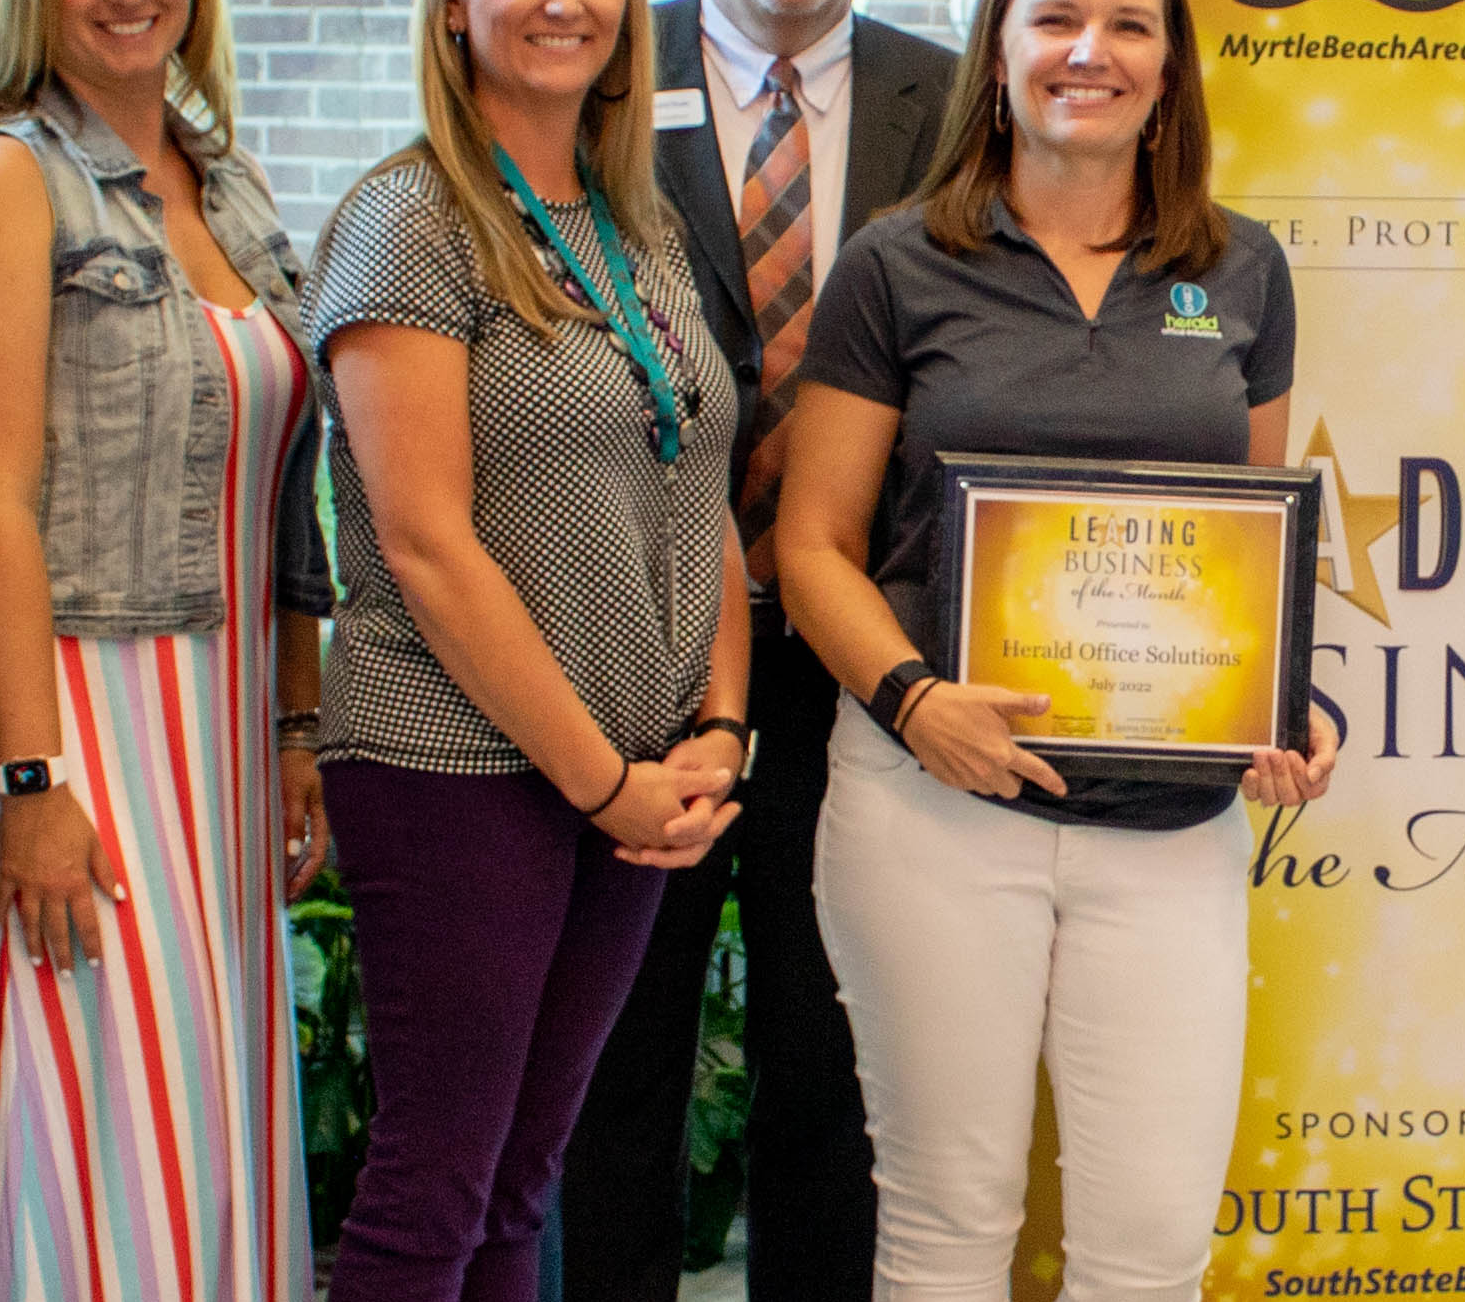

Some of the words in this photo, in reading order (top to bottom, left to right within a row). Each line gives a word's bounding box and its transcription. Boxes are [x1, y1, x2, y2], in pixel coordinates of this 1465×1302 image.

[1070, 514, 1196, 547] LEADING
[1064, 550, 1203, 579] BUSINESS
[1002, 639, 1072, 660] Herald
[1079, 641, 1140, 663] Office
[1145, 644, 1242, 667] Solutions
[1087, 677, 1117, 693] July
[1119, 681, 1153, 693] 2022
